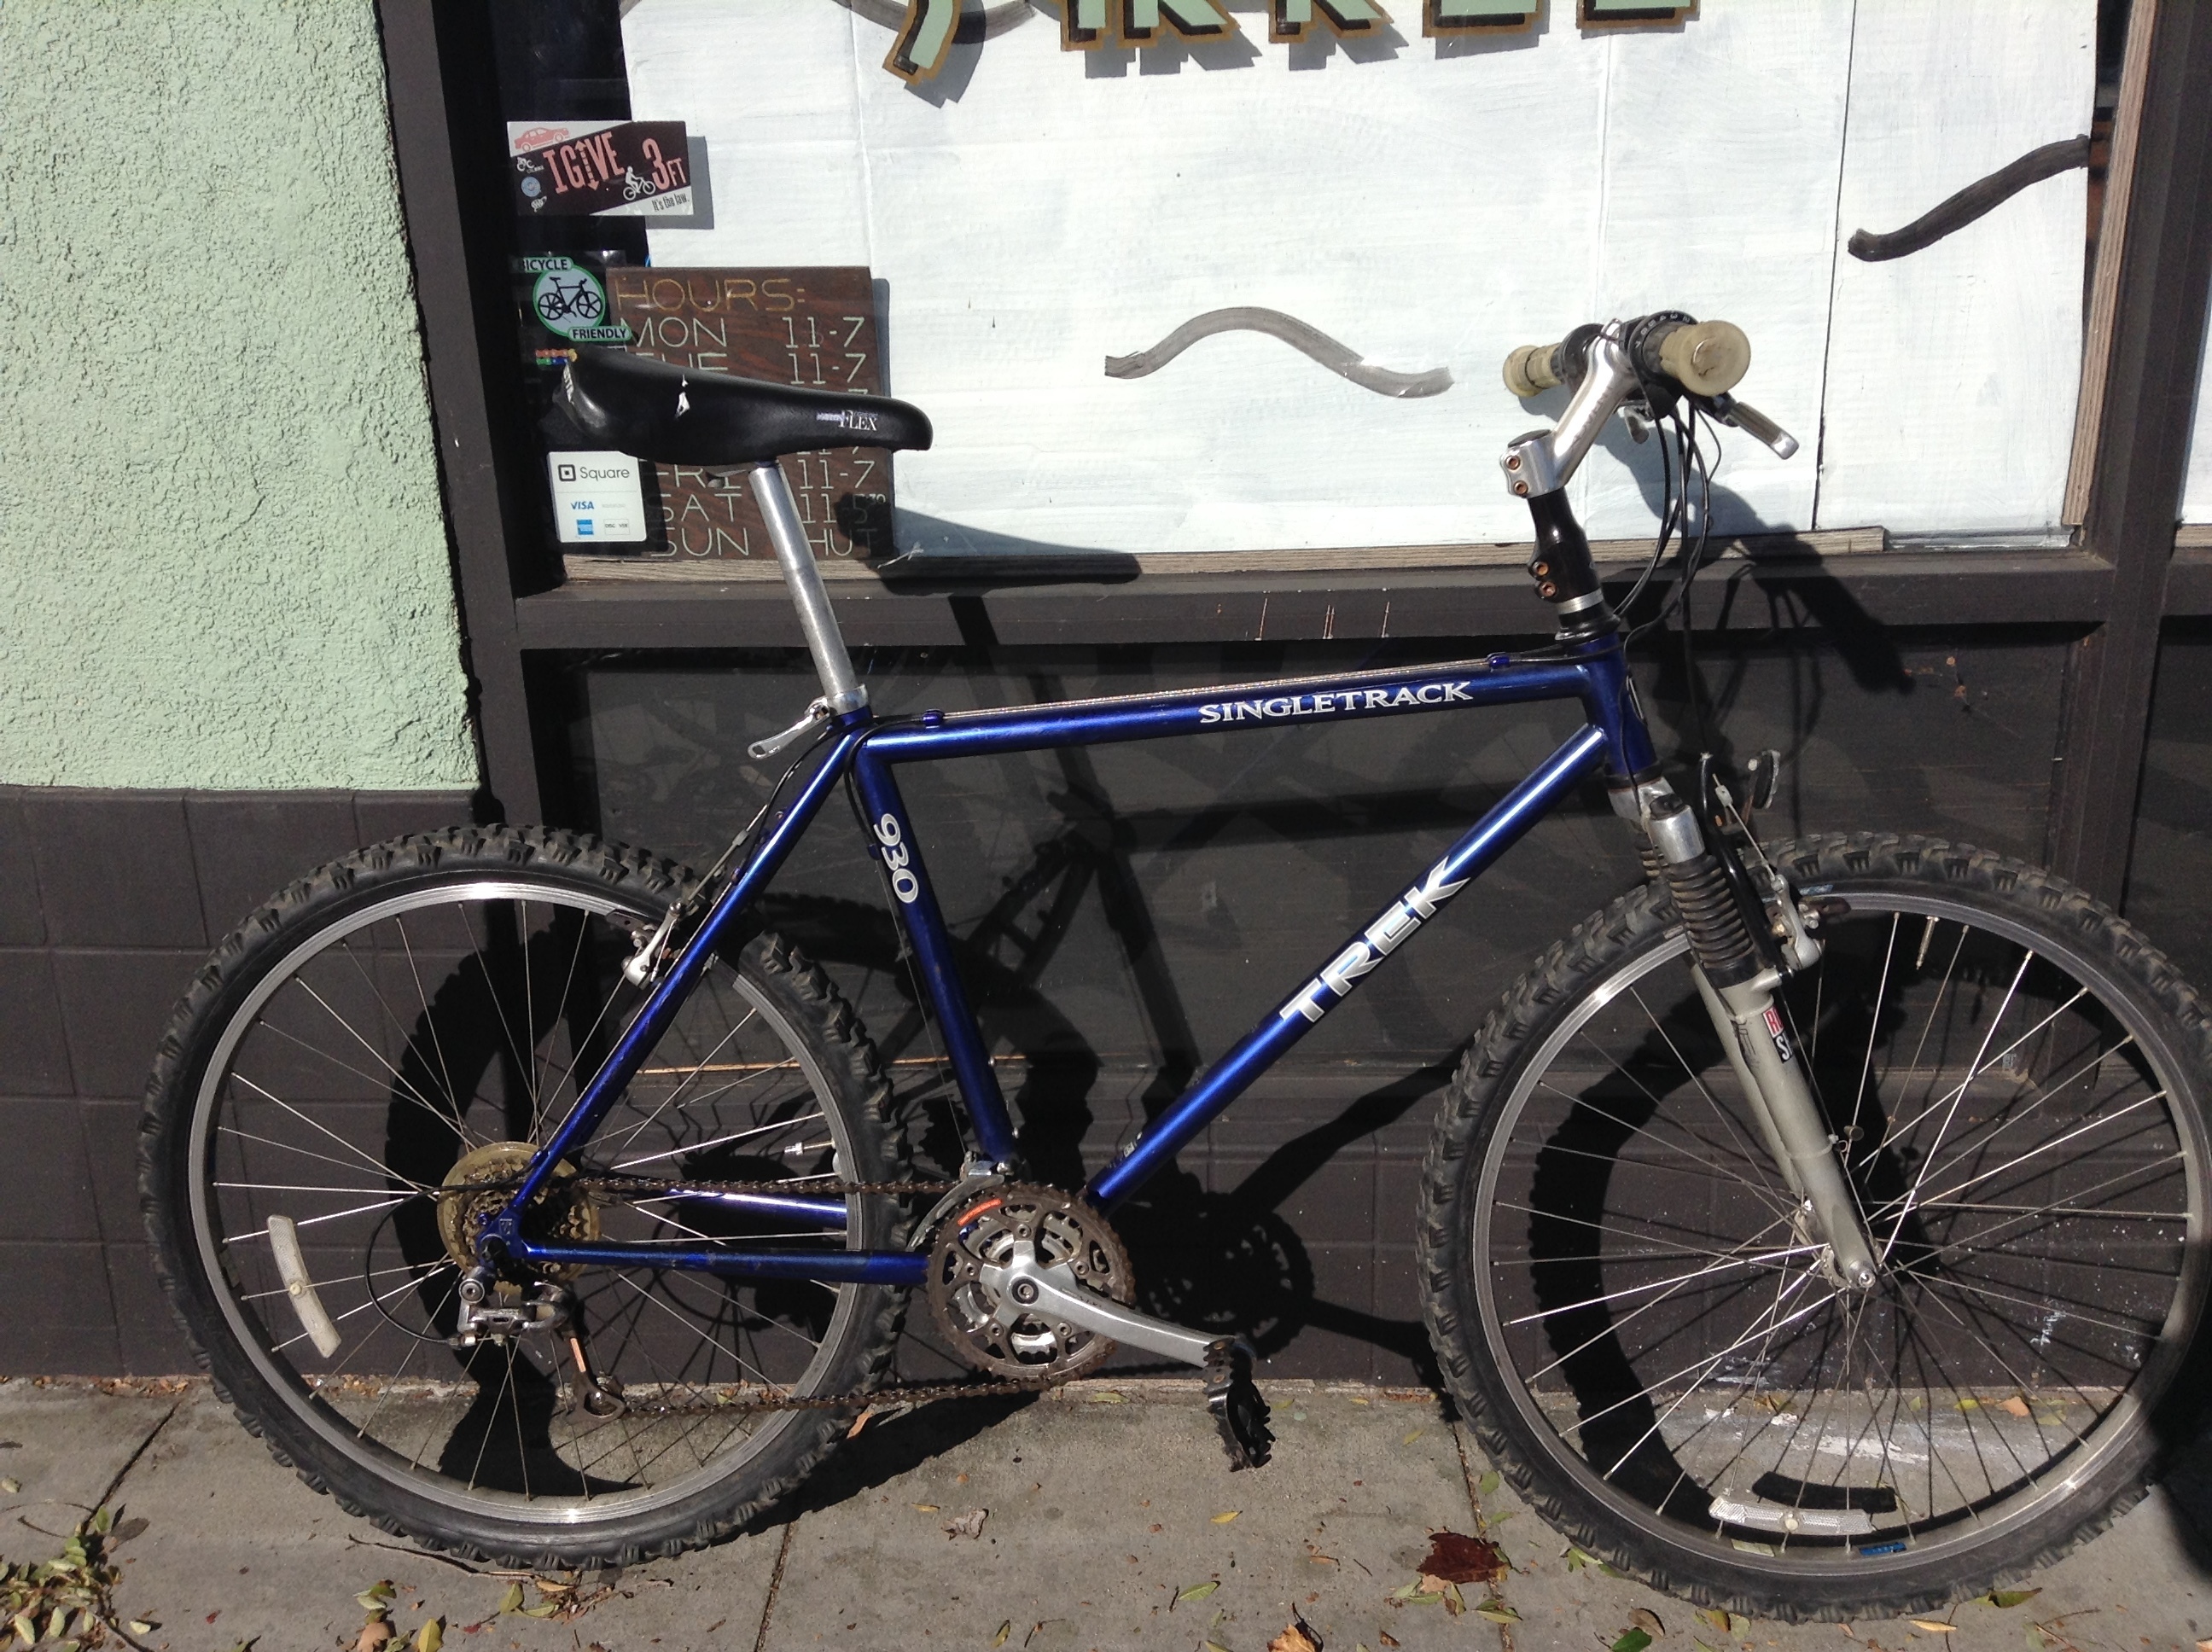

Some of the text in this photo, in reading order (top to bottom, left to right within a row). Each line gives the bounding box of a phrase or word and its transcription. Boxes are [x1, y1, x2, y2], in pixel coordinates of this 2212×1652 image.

[522, 259, 568, 271] ICYCLE
[615, 278, 805, 311] HOURS:
[573, 329, 627, 339] FRIENDLY
[579, 466, 631, 482] Square
[571, 501, 595, 510] VISA
[1199, 681, 1473, 724] SINGLETRACK
[873, 813, 919, 904] 930
[1279, 855, 1471, 1022] TREK
